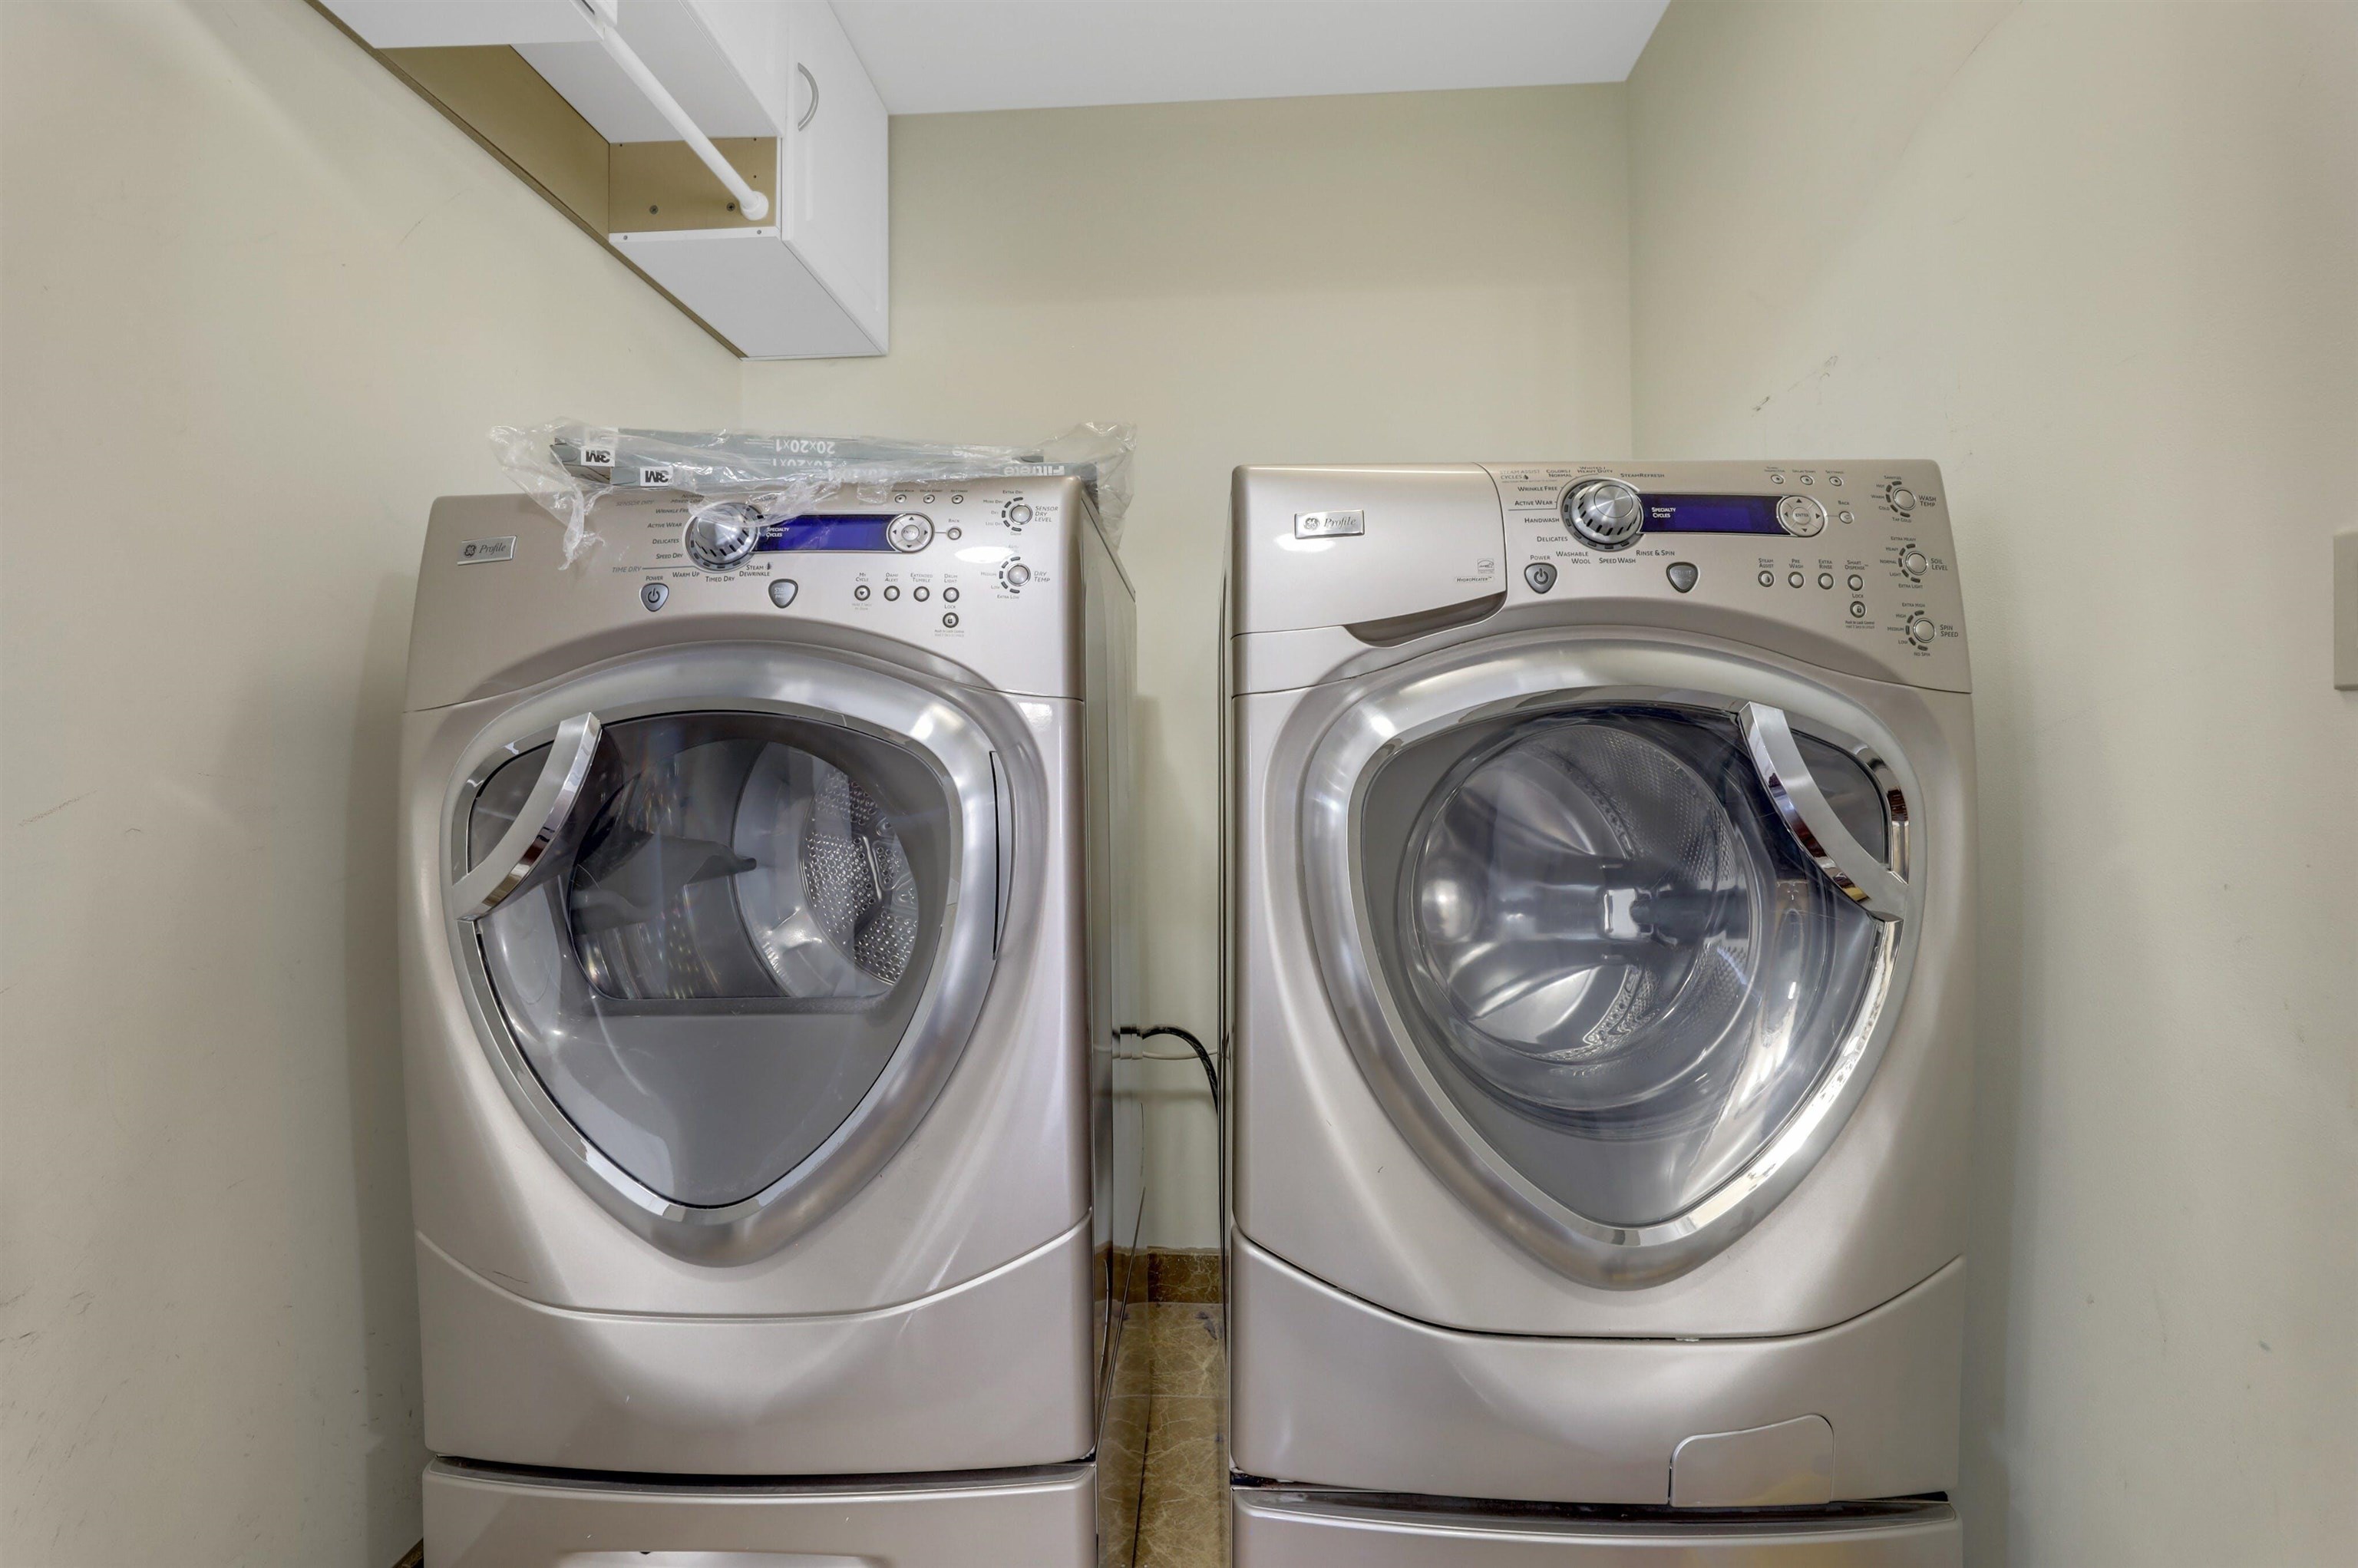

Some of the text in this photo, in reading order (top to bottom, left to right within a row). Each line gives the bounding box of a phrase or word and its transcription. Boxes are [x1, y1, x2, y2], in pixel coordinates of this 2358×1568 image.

[775, 439, 836, 454] 20x20x1
[586, 450, 611, 463] 3M
[645, 470, 669, 483] 3M
[1323, 516, 1356, 529] Profile
[479, 542, 507, 556] Profile
